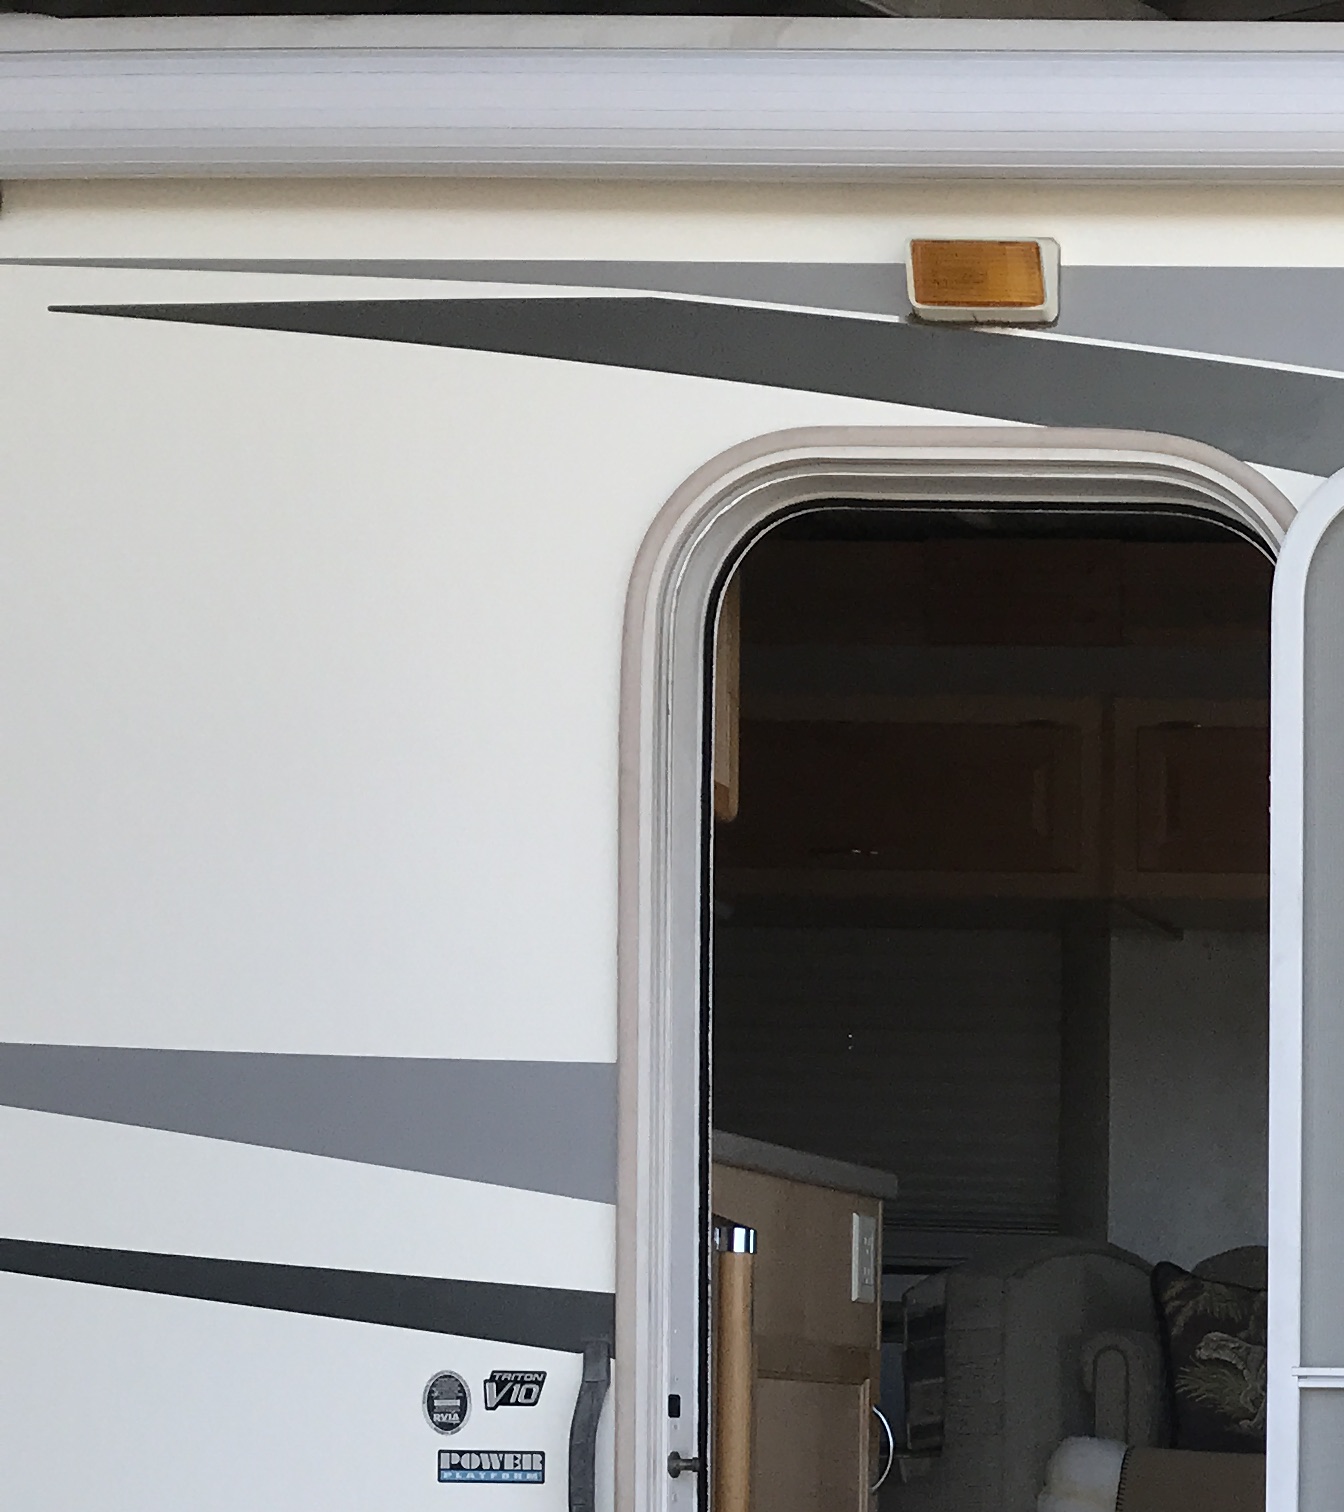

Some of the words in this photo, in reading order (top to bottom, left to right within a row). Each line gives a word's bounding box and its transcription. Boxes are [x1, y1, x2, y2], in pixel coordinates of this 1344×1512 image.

[492, 1372, 544, 1381] TRITON
[485, 1382, 541, 1408] V10
[440, 1452, 543, 1471] POWER
[443, 1472, 541, 1481] PLATFORM
